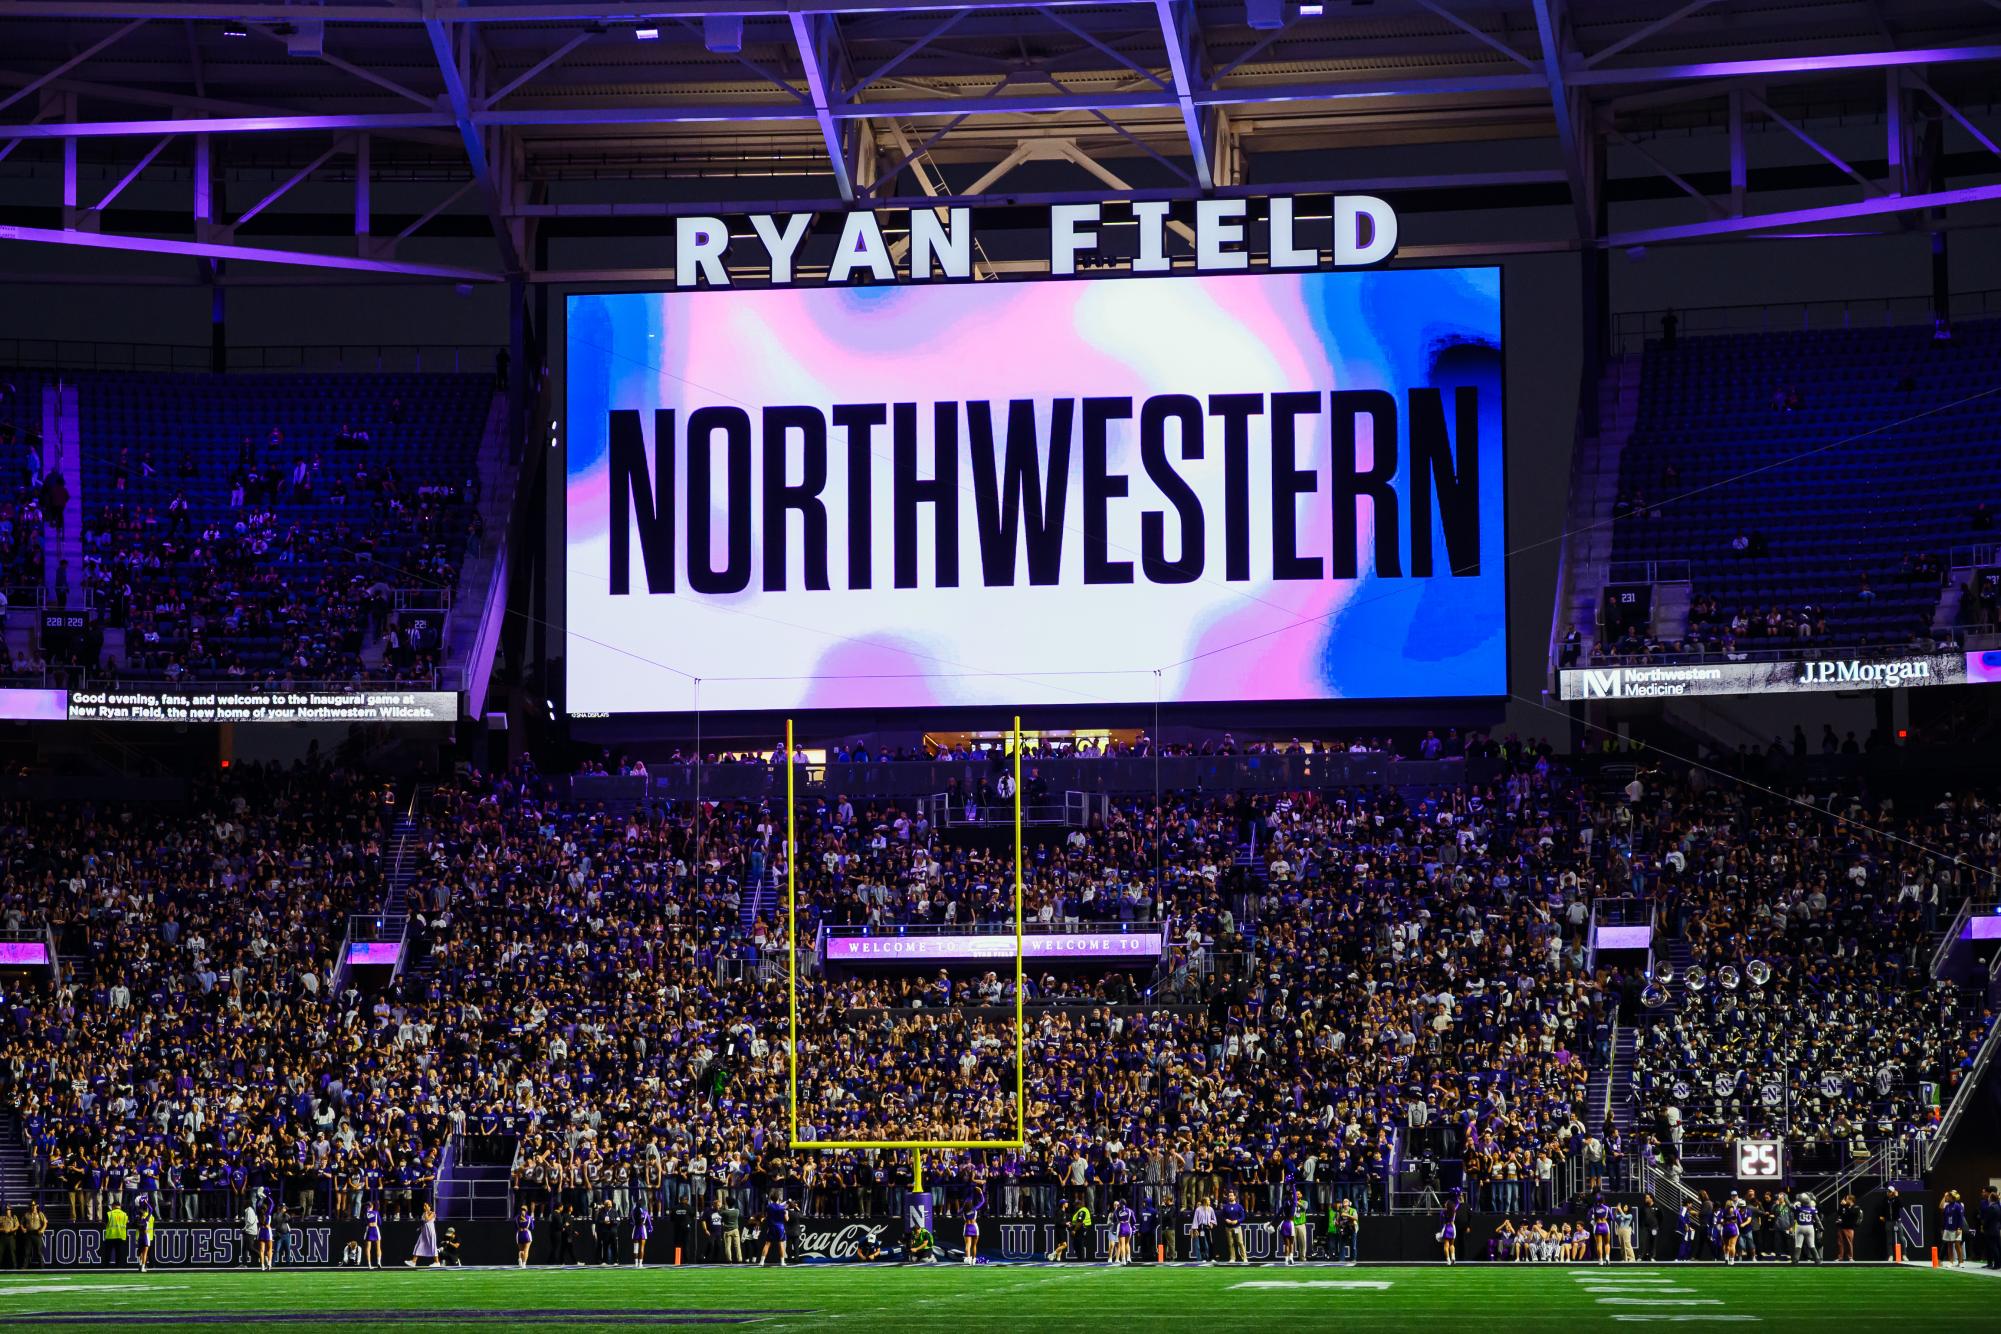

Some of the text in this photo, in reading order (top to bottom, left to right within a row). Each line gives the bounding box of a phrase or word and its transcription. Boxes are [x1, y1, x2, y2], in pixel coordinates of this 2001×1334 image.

[676, 196, 1398, 286] RYAN FIELD
[608, 387, 1480, 596] NORTHWESTERN
[1622, 593, 1636, 603] 231
[47, 617, 83, 627] 228 229
[1625, 668, 1721, 681] Northwestern
[1800, 660, 1930, 687] J.P.Morgan
[73, 693, 415, 706] Good evening, fans, and welcome to the inaugural game at
[69, 706, 434, 719] New Ryan Field, the new home of your Northwestern Wildcats.
[849, 942, 956, 952] WELCOME TO
[1032, 939, 1140, 950] WELCOME TO
[1721, 1081, 1729, 1092] N
[1827, 1080, 1837, 1093] N
[1881, 1074, 1888, 1089] N
[1678, 1084, 1687, 1095] N
[1768, 1088, 1777, 1100] N
[1552, 1108, 1562, 1118] 43
[1741, 1144, 1776, 1175] 25
[908, 1204, 925, 1229] N
[1899, 1204, 1925, 1248] N
